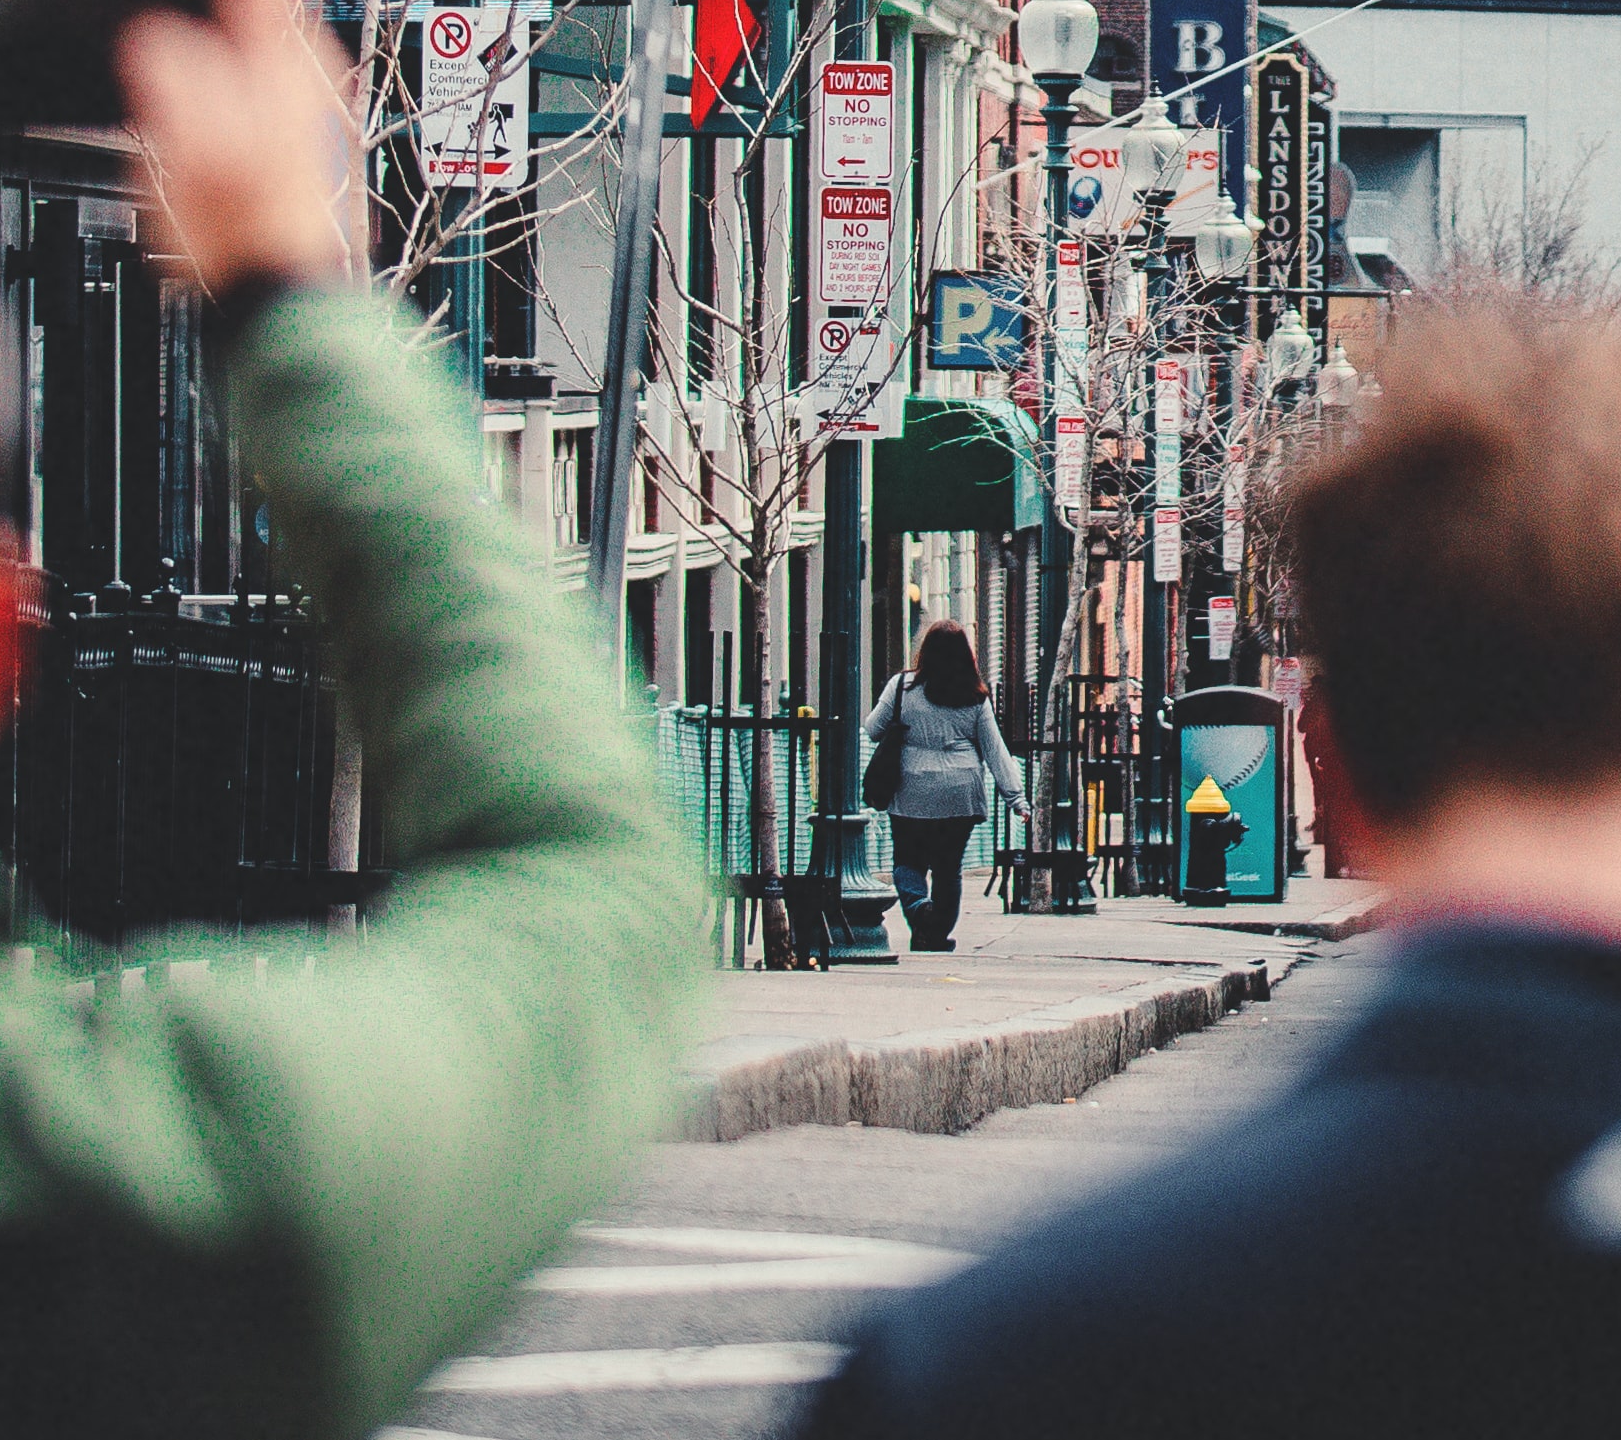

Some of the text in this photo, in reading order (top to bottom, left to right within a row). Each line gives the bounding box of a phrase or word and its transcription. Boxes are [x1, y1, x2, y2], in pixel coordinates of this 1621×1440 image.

[429, 73, 488, 86] Commerci
[828, 71, 889, 91] TOW ZONE
[1267, 75, 1291, 86] THE
[428, 86, 468, 97] Vehic
[844, 98, 870, 114] NO
[828, 115, 888, 127] STOPPING
[826, 196, 888, 215] TOW ZONE
[843, 222, 869, 238] NO
[826, 240, 886, 251] STOPPING
[831, 251, 853, 261] DURING
[854, 251, 867, 261] RED
[830, 274, 835, 283] 4
[836, 274, 856, 283] HOURS
